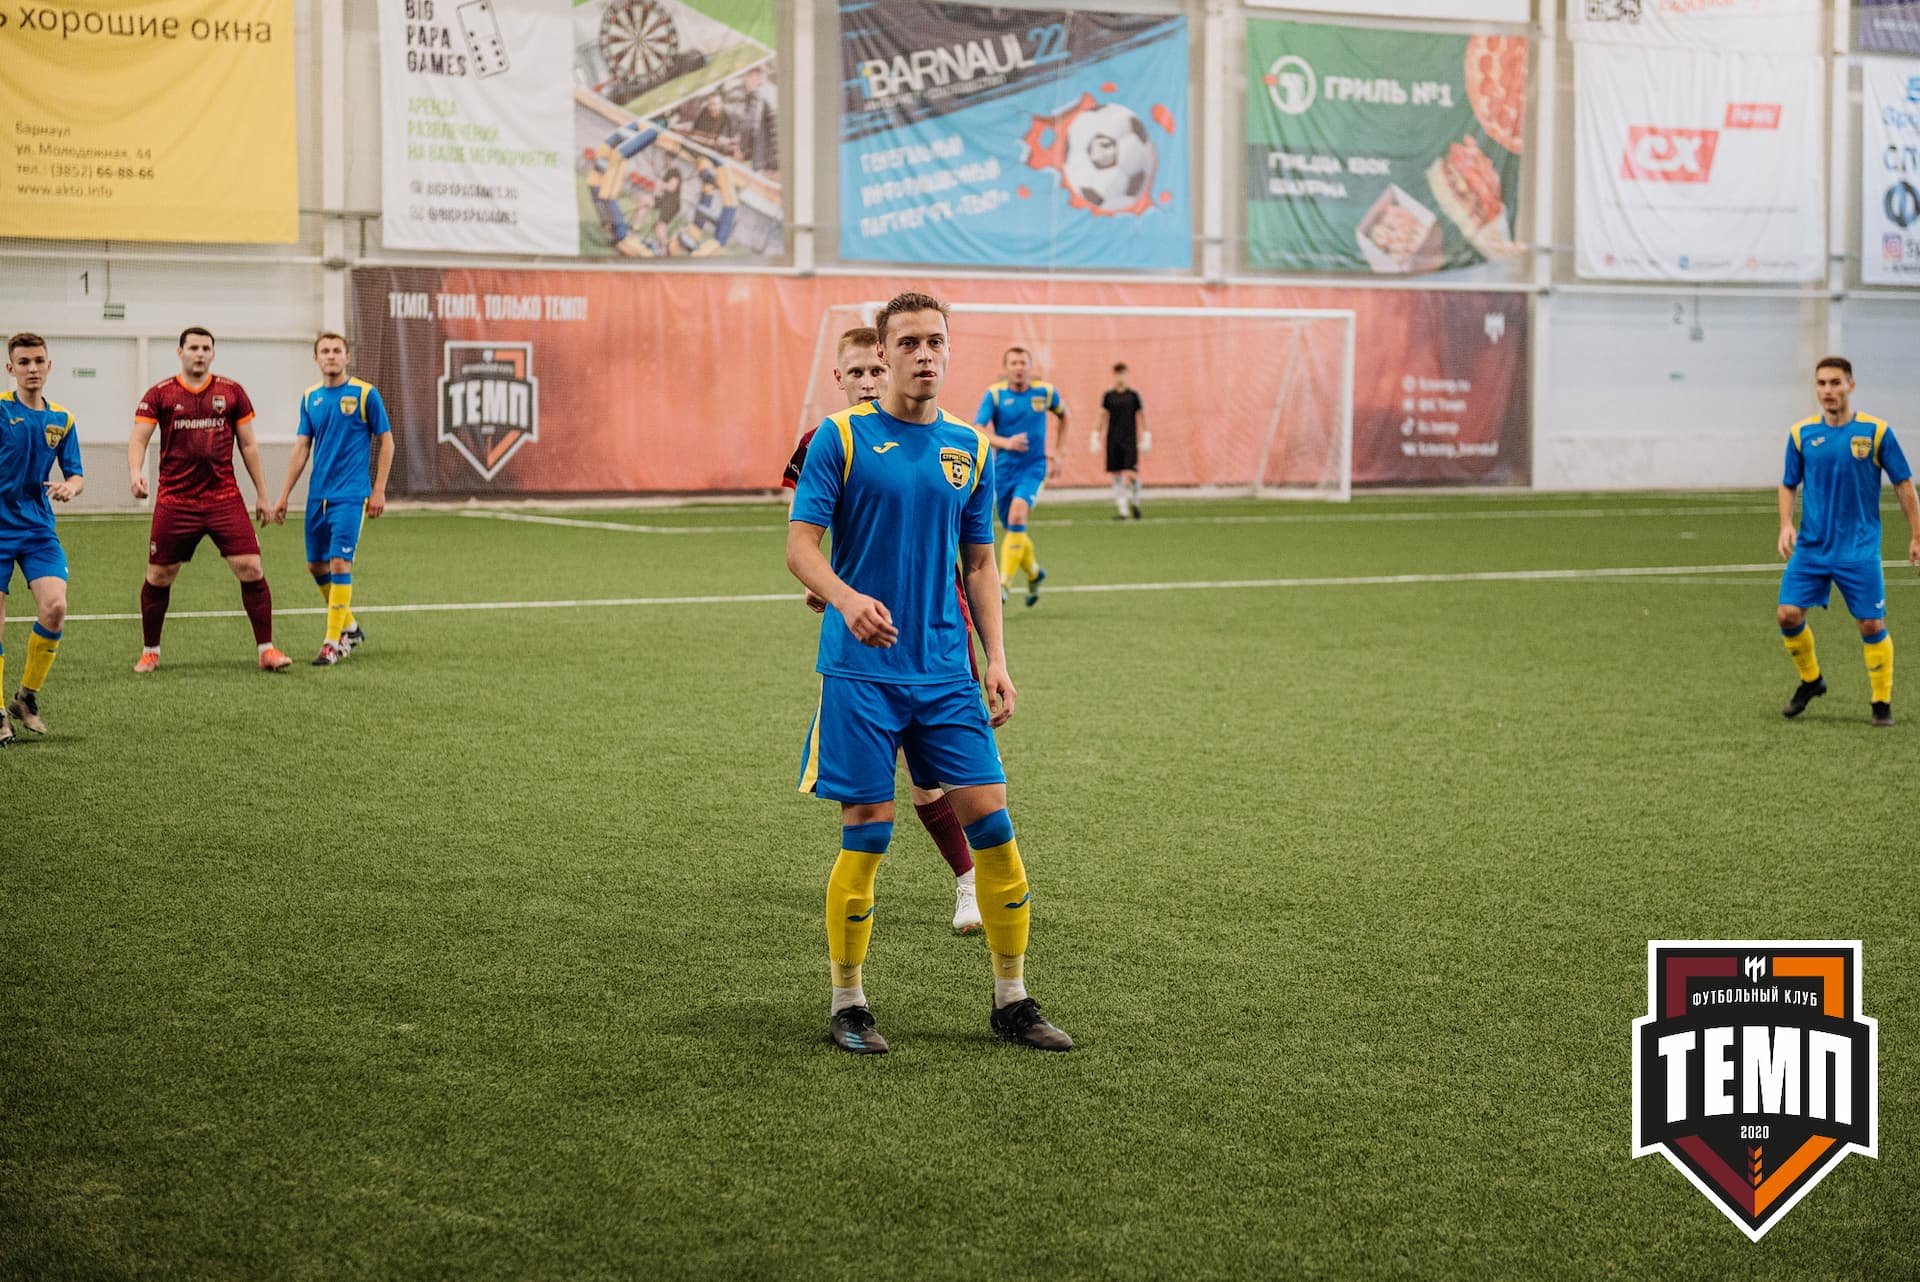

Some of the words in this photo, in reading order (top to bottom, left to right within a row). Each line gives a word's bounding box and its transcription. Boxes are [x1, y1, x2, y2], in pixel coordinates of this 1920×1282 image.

[406, 0, 434, 20] BIG
[19, 6, 180, 40] хорошие
[191, 18, 272, 43] окна
[406, 25, 451, 49] PAPA
[407, 50, 467, 77] GAMES
[1324, 76, 1408, 105] ГРИЛЬ
[15, 120, 72, 138] Барнаул
[80, 270, 88, 295] 1
[389, 293, 433, 321] ТЕМП,
[436, 293, 481, 321] ТЕМП,
[484, 294, 541, 321] ТОЛЬКО
[448, 380, 529, 429] ТЕМП
